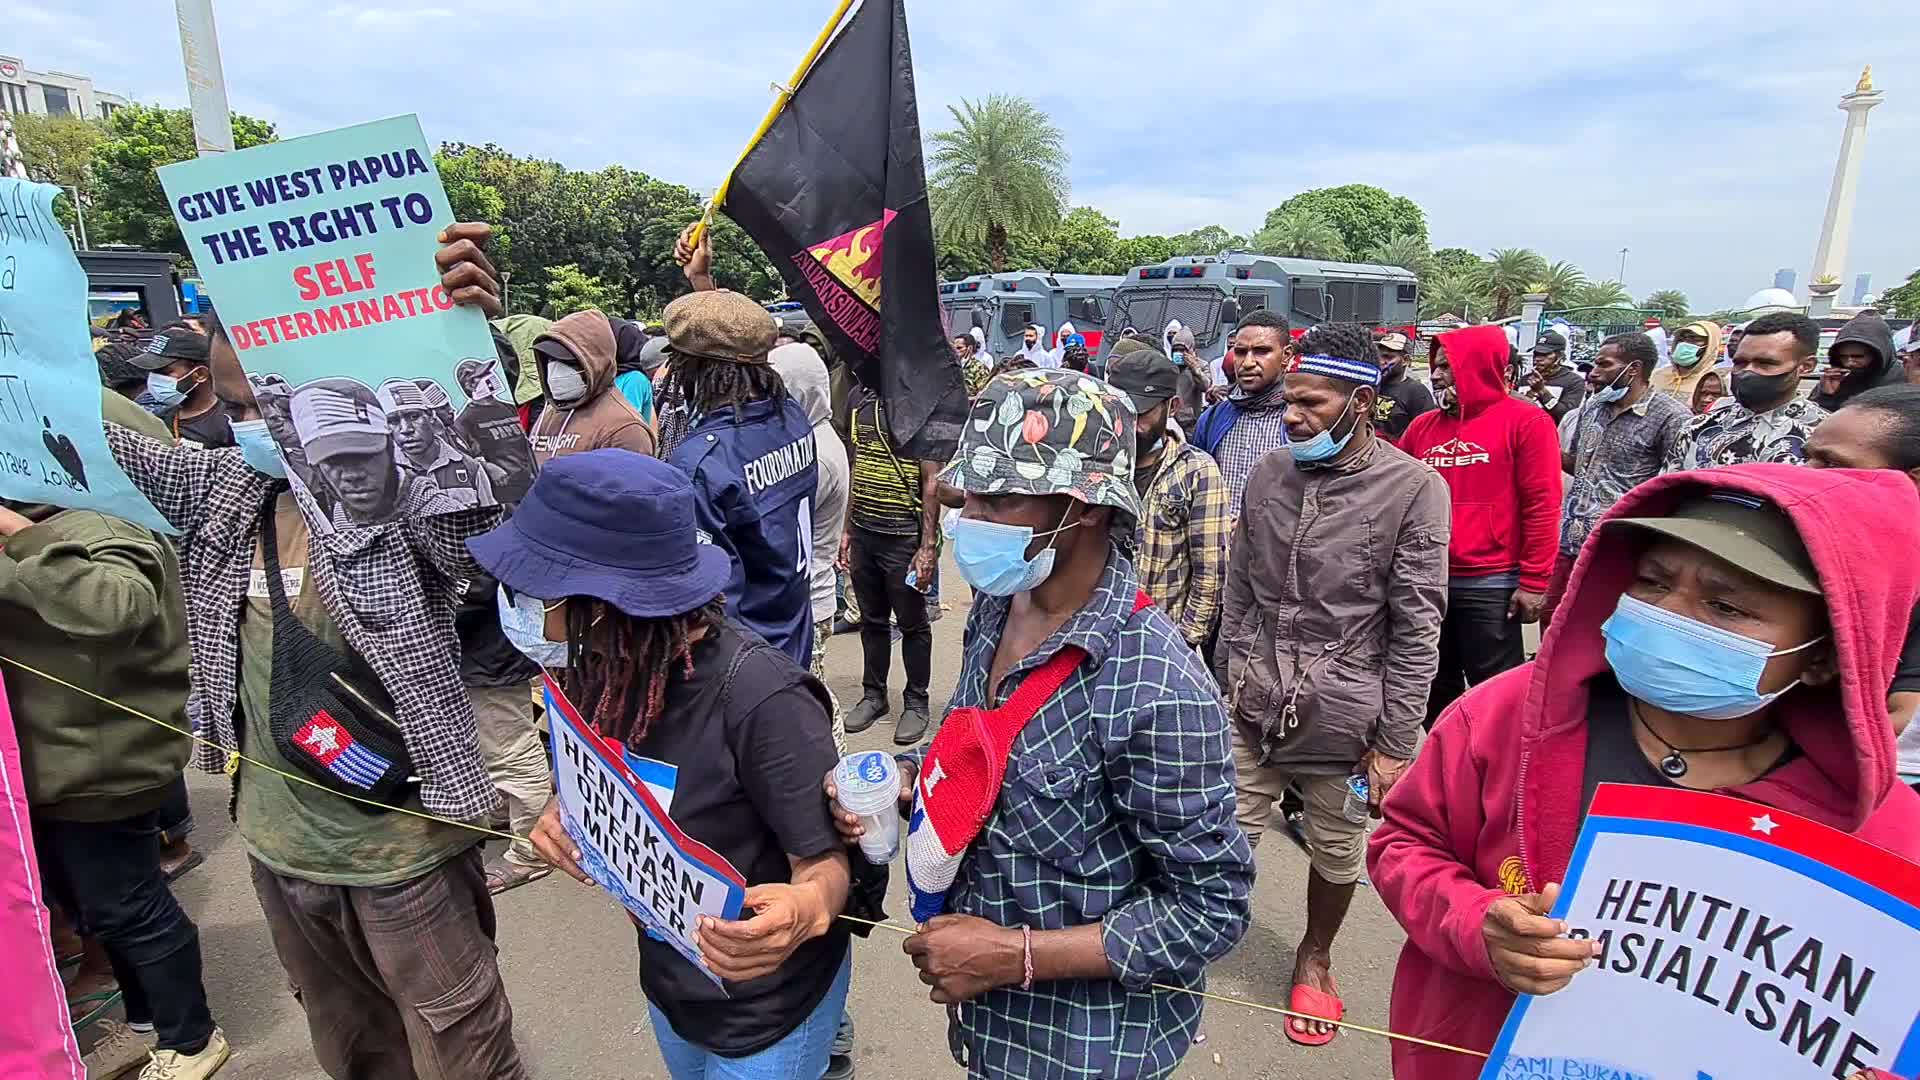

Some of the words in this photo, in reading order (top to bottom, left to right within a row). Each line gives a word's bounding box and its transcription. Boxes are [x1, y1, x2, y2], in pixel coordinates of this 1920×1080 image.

[178, 185, 246, 222] GIVE
[245, 168, 323, 207] WEST
[327, 148, 428, 191] PAPUA
[202, 225, 268, 264] THE
[268, 202, 378, 252] RIGHT
[380, 192, 433, 229] TO
[230, 284, 460, 350] DETERMINATIO
[293, 253, 376, 301] SELF
[563, 731, 705, 907] HENTIKAN
[576, 772, 685, 916] OPERASI
[584, 807, 686, 938] MILITER
[1568, 928, 1880, 1080] ASIALISME
[1596, 878, 1875, 1016] HENTIKAN
